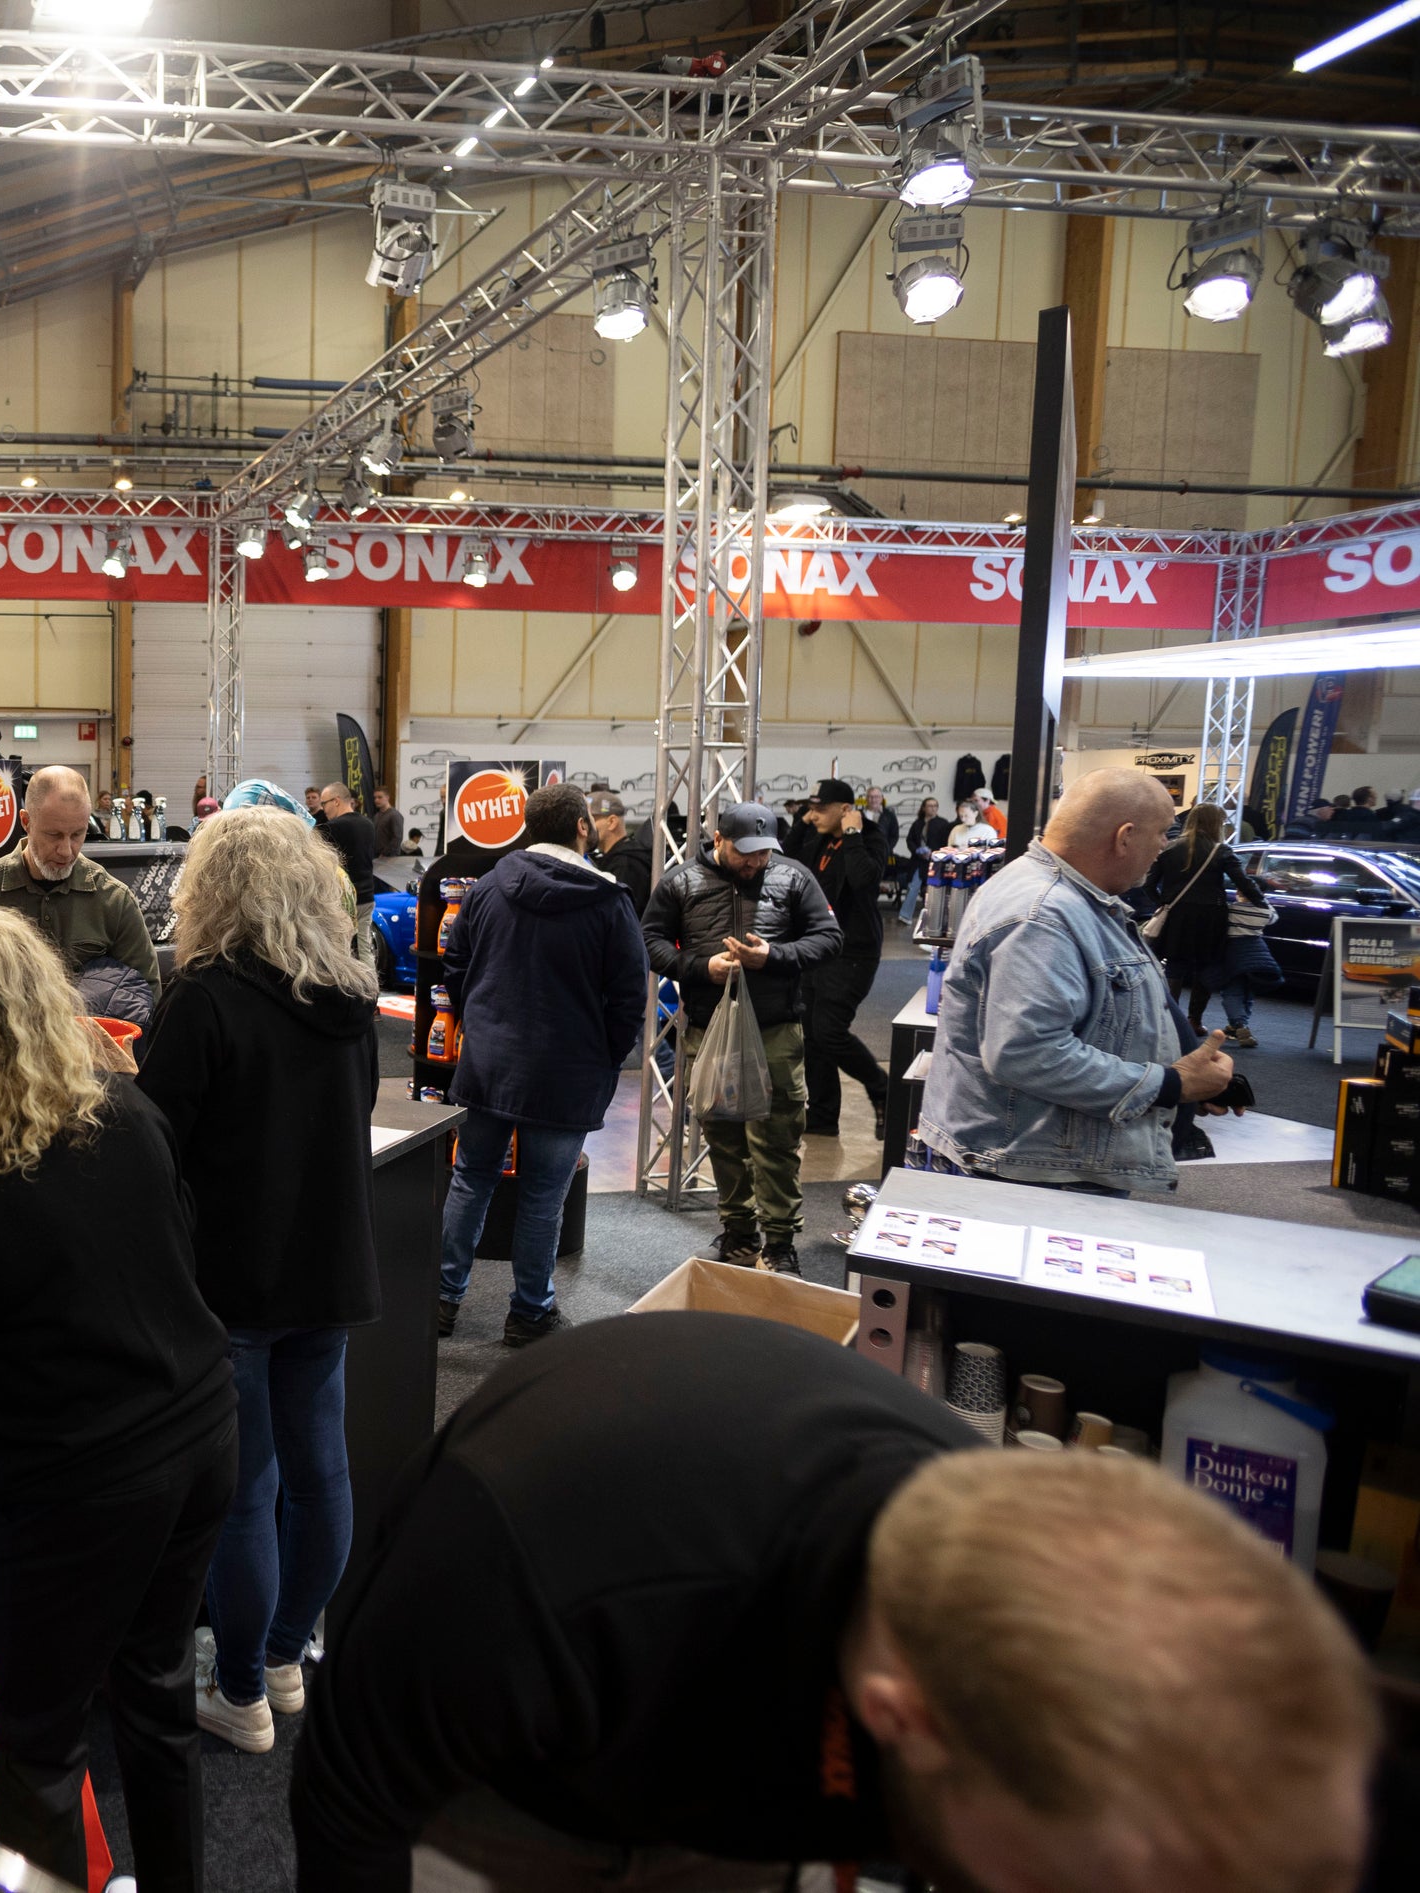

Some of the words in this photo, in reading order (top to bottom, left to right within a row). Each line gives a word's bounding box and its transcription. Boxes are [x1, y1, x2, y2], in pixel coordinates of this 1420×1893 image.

[324, 530, 535, 586] SONAX
[678, 547, 879, 597] SONAX
[463, 795, 521, 823] NYHET
[169, 863, 186, 895] SONA
[141, 888, 156, 910] NAX
[1348, 938, 1377, 947] BOKA
[1380, 939, 1394, 947] EN
[1193, 1453, 1288, 1490] Dunken
[1193, 1470, 1266, 1503] Donje
